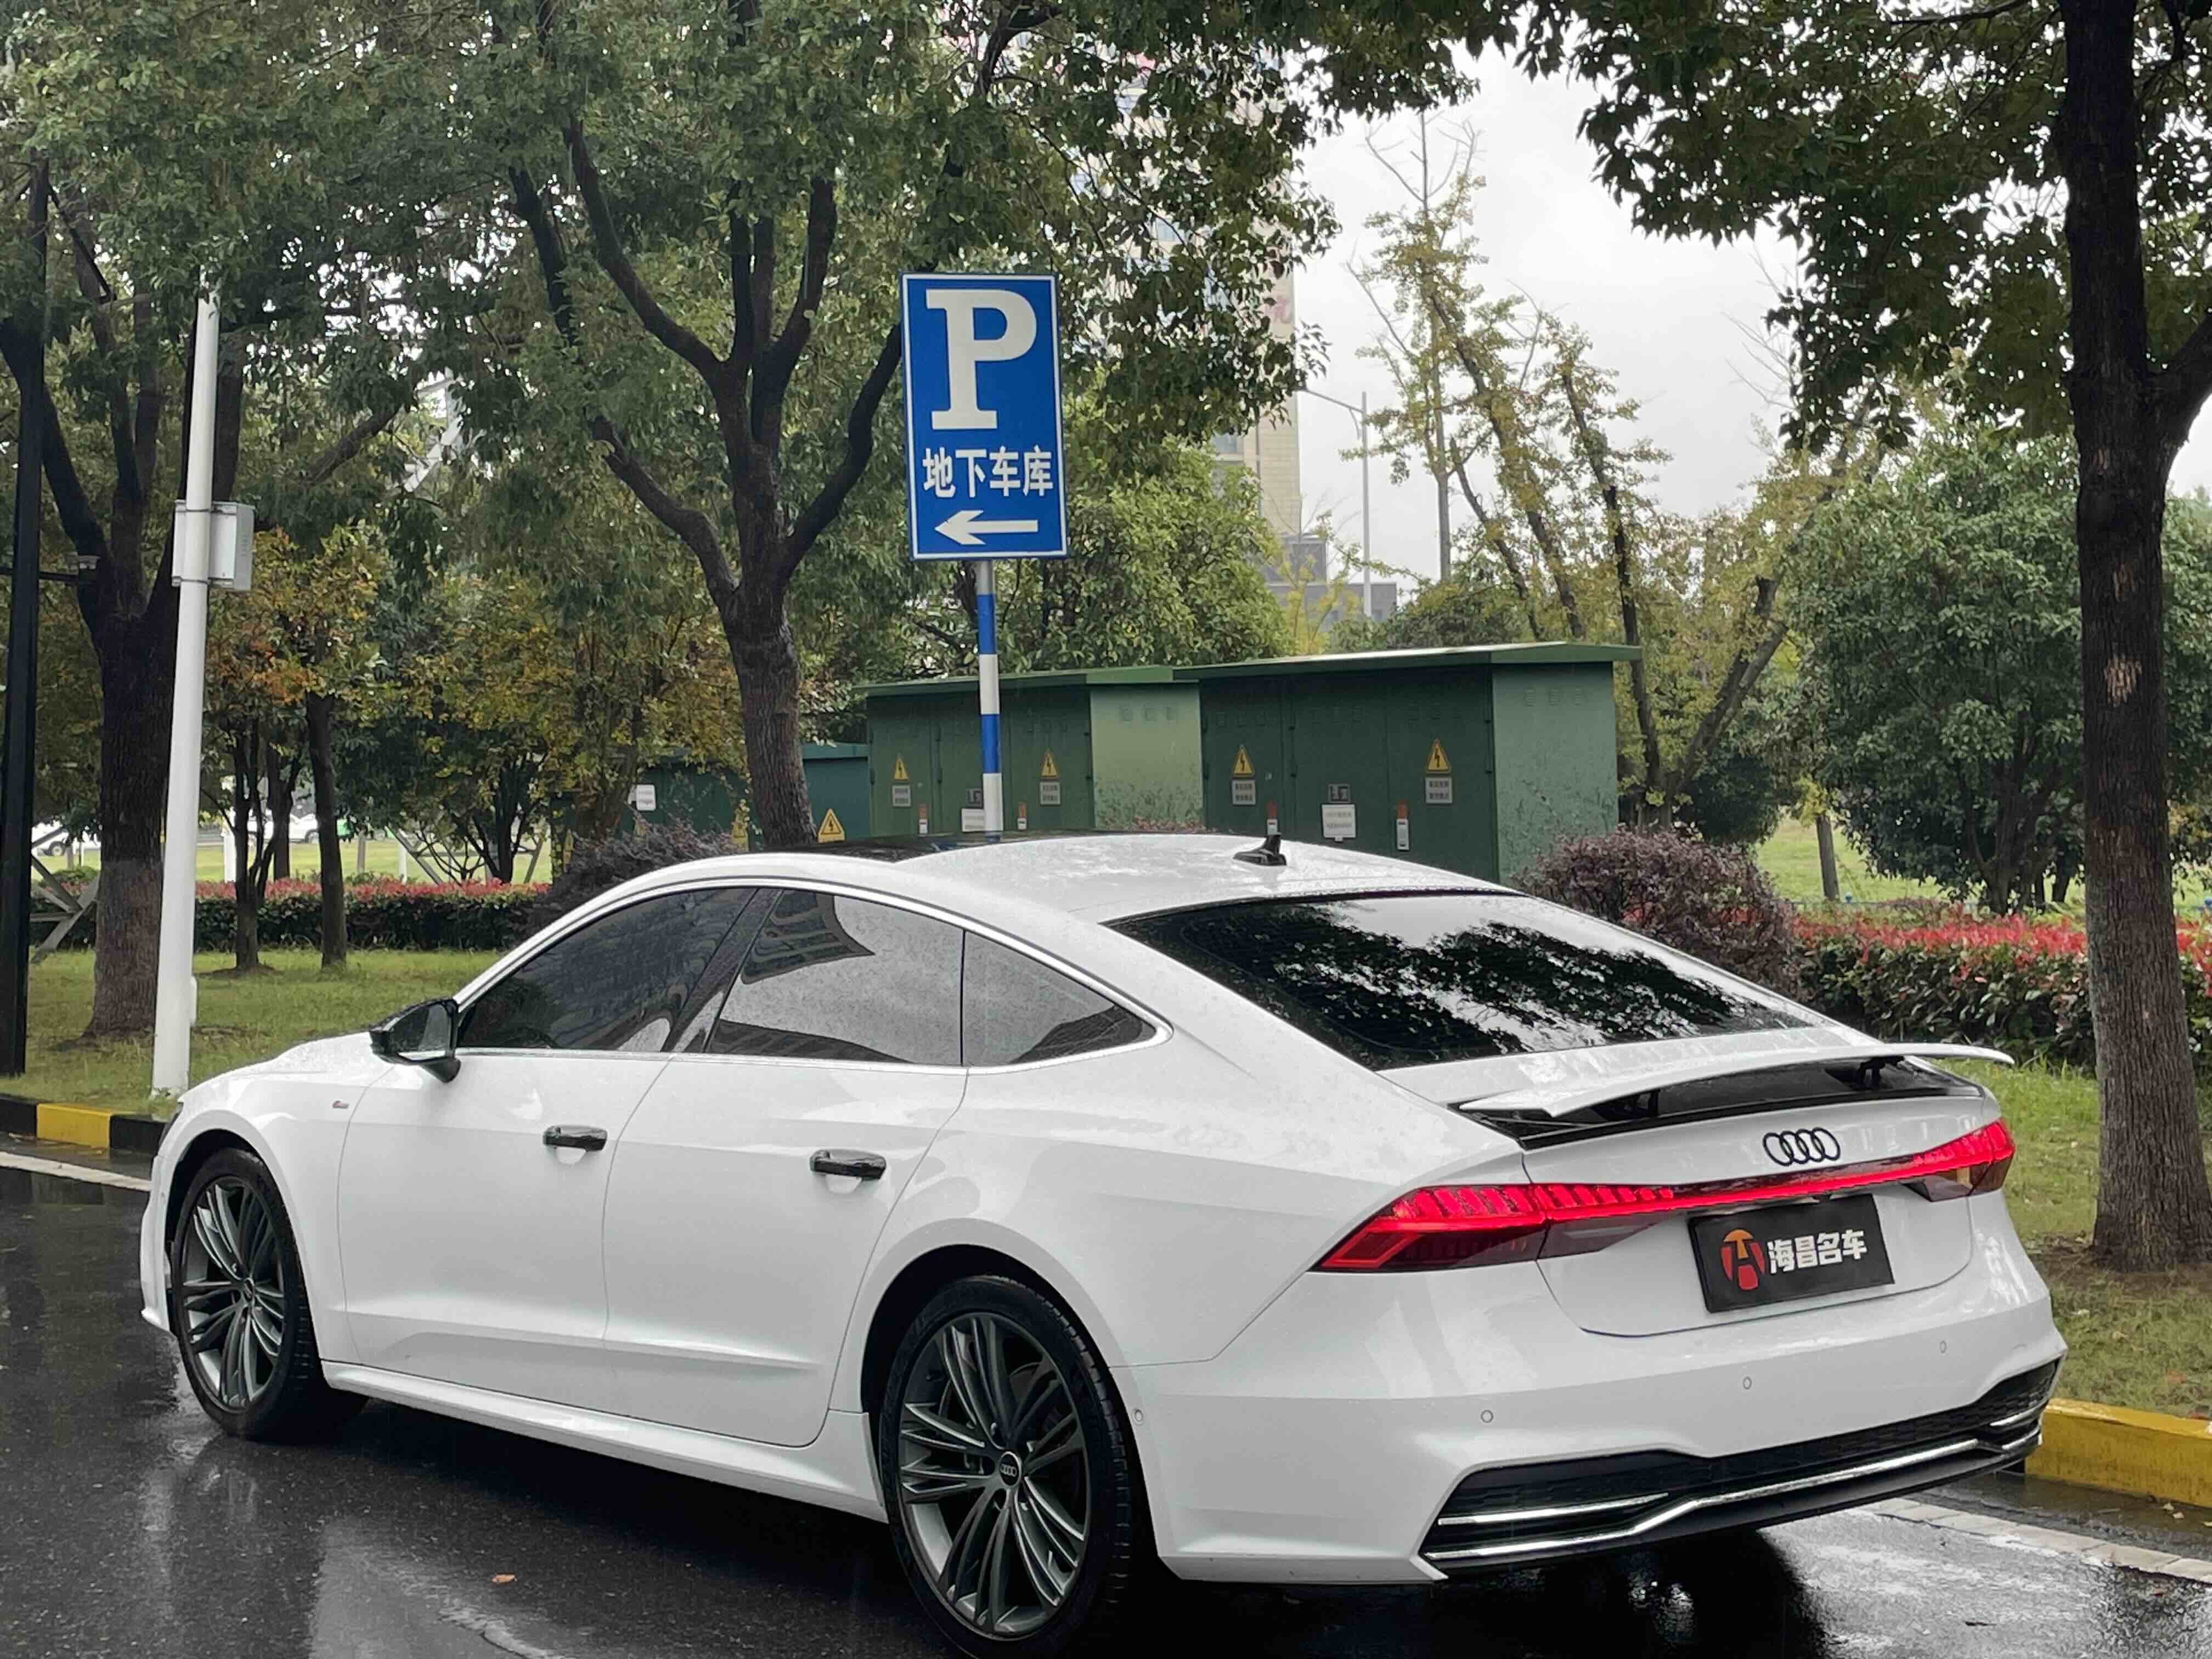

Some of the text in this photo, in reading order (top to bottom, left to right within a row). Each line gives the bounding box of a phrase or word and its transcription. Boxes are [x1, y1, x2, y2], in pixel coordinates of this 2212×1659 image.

[926, 289, 1037, 430] P
[922, 444, 1054, 498] 地下车库
[1767, 1229, 1867, 1274] 海昌名车
